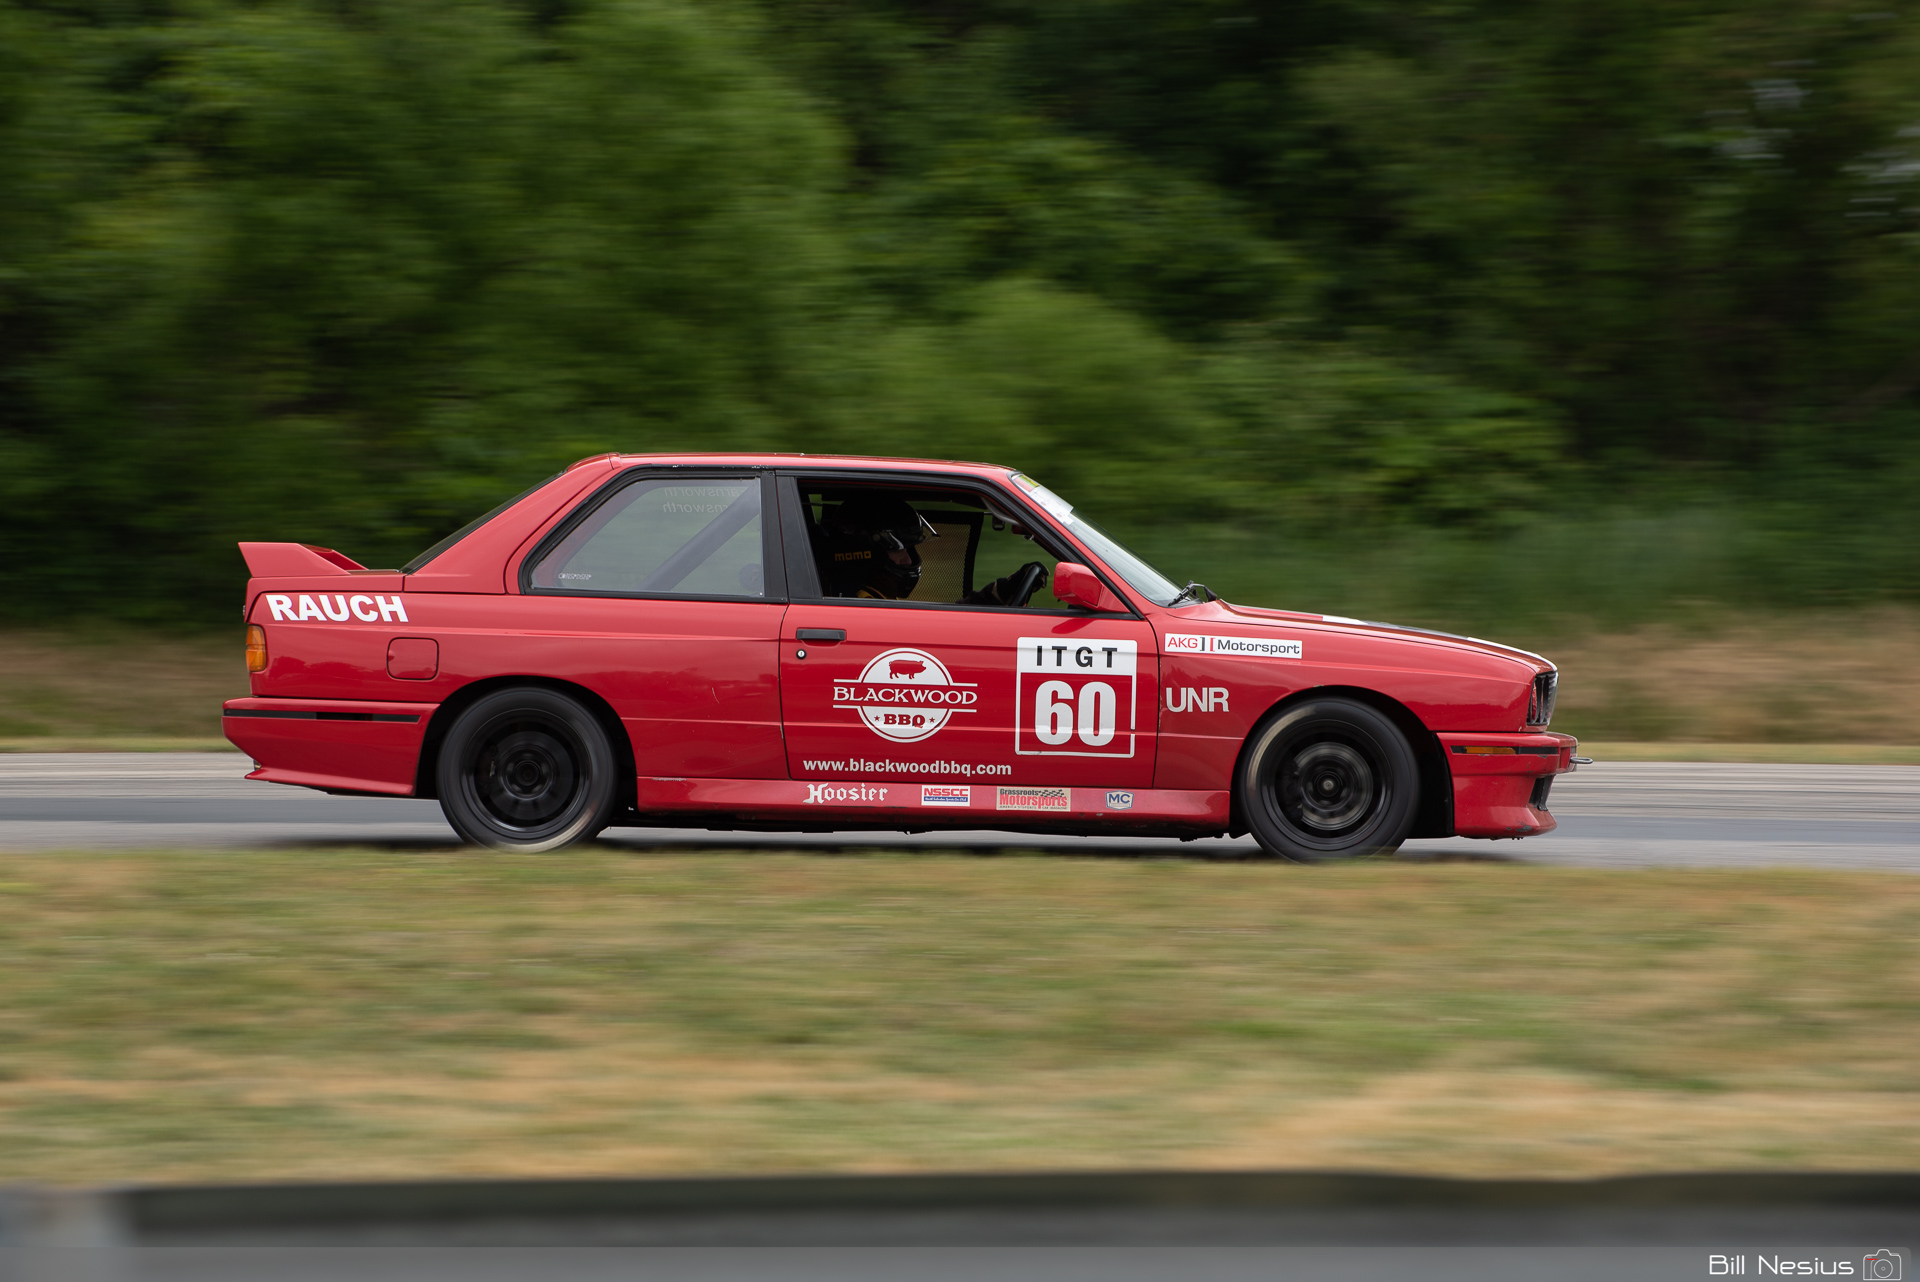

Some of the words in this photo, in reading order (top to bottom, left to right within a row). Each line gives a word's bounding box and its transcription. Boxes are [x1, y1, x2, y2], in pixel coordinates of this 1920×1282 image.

[265, 594, 409, 623] RAUCH
[1217, 639, 1300, 655] Motorsport
[833, 686, 978, 705] BLACKWOOD
[1165, 687, 1230, 713] UNR
[883, 713, 926, 729] BBQ
[1034, 680, 1117, 747] 60
[803, 758, 1012, 777] www.blackwoodbbq.com
[802, 782, 888, 804] Hoosier
[923, 787, 969, 797] NSSCC
[1000, 788, 1039, 796] Grassroots
[1108, 793, 1131, 804] MC
[999, 794, 1067, 809] Motorsports
